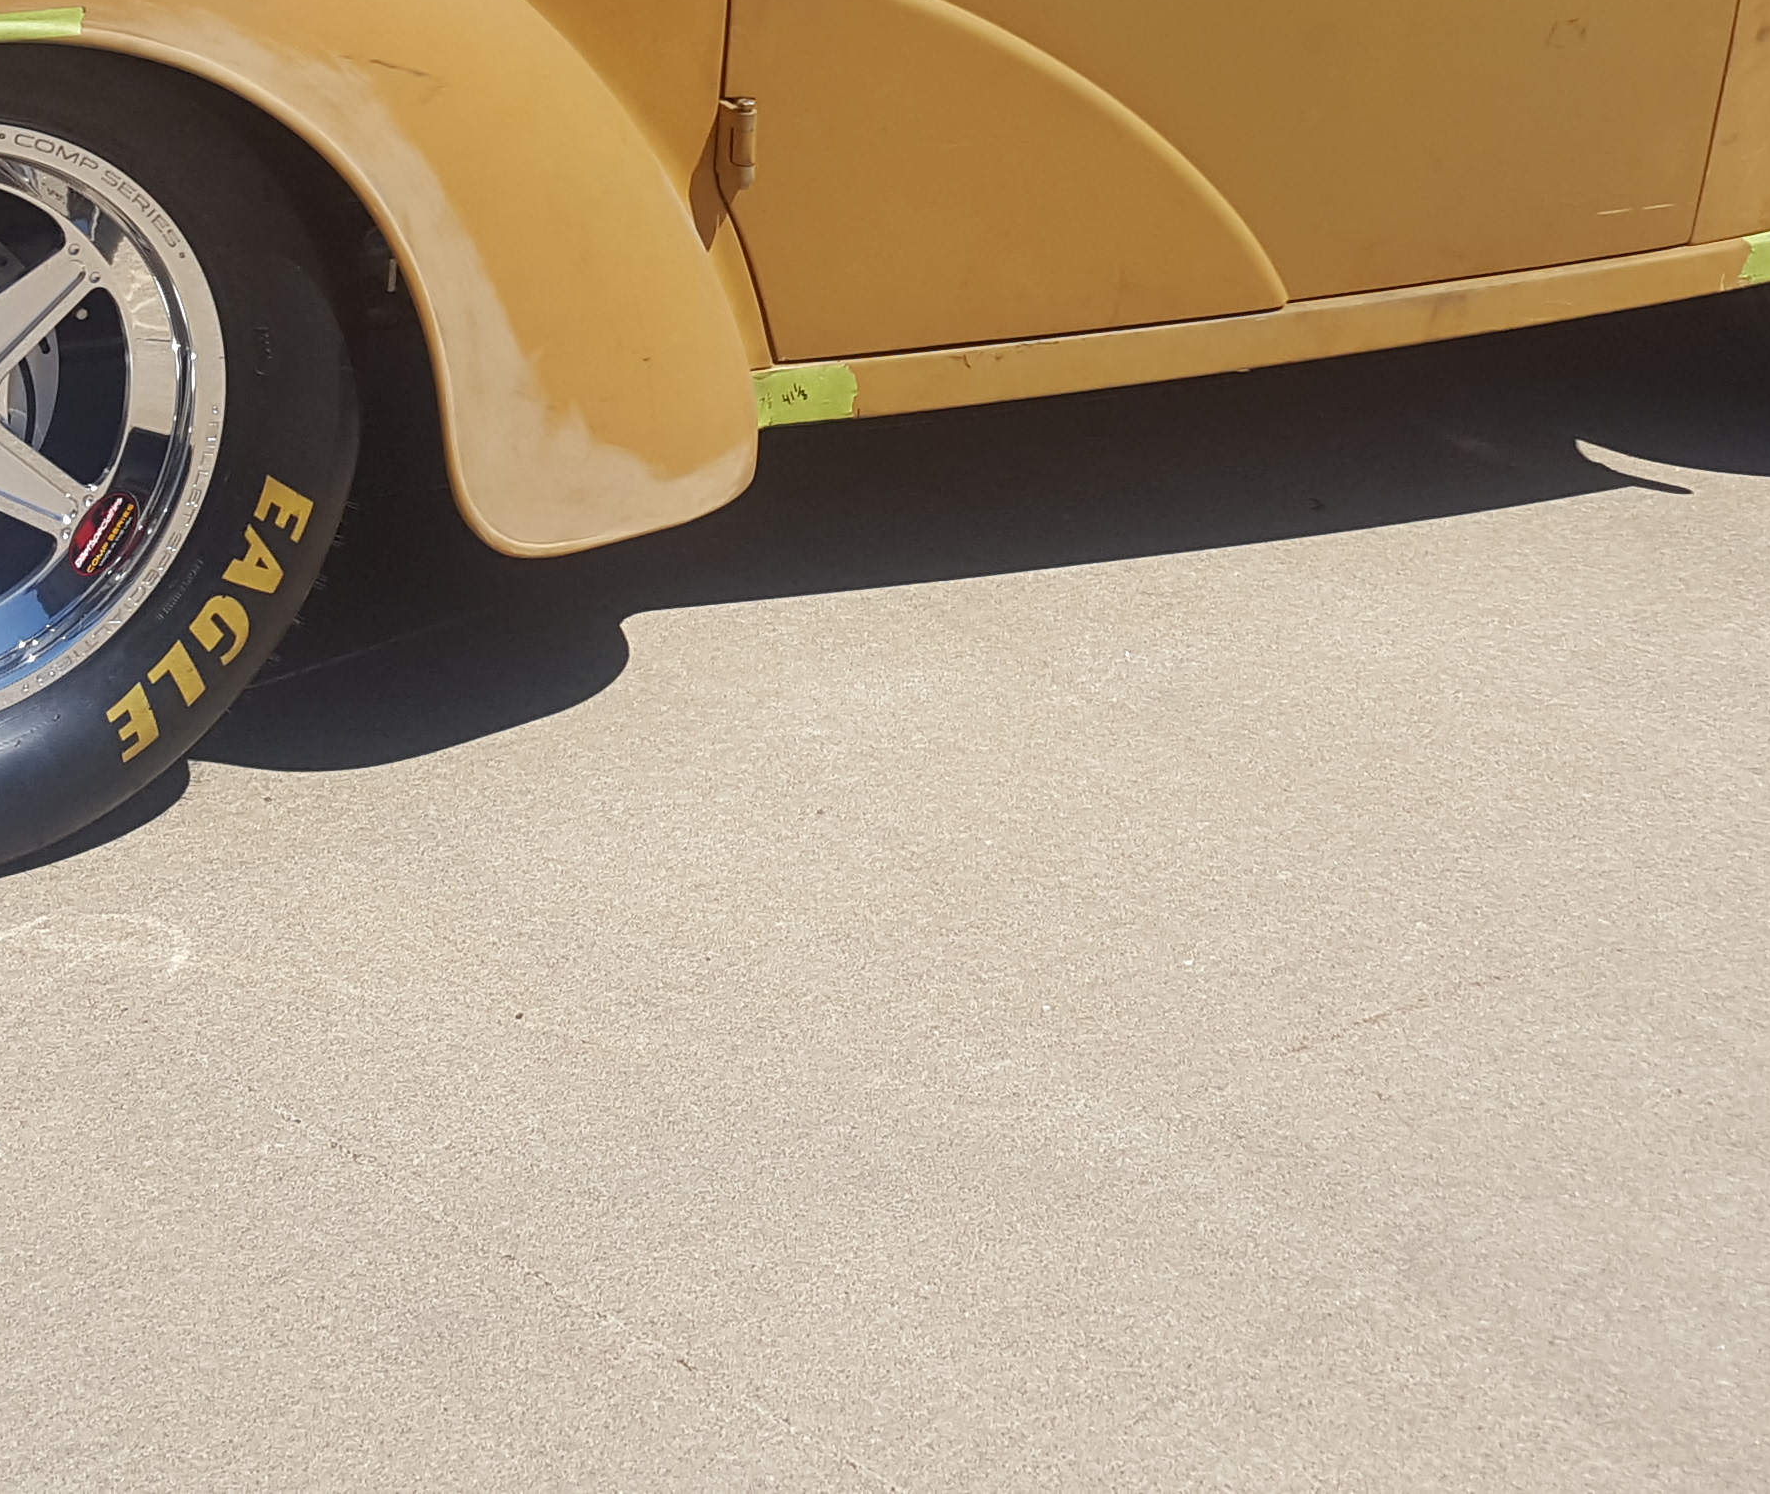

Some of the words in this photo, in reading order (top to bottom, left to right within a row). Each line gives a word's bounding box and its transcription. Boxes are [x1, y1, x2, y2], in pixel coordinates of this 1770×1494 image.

[14, 133, 99, 171] COMP
[100, 169, 182, 249] SERIES
[86, 541, 109, 573] COMP
[107, 503, 135, 542] SERIES
[106, 474, 315, 763] EAGLE
